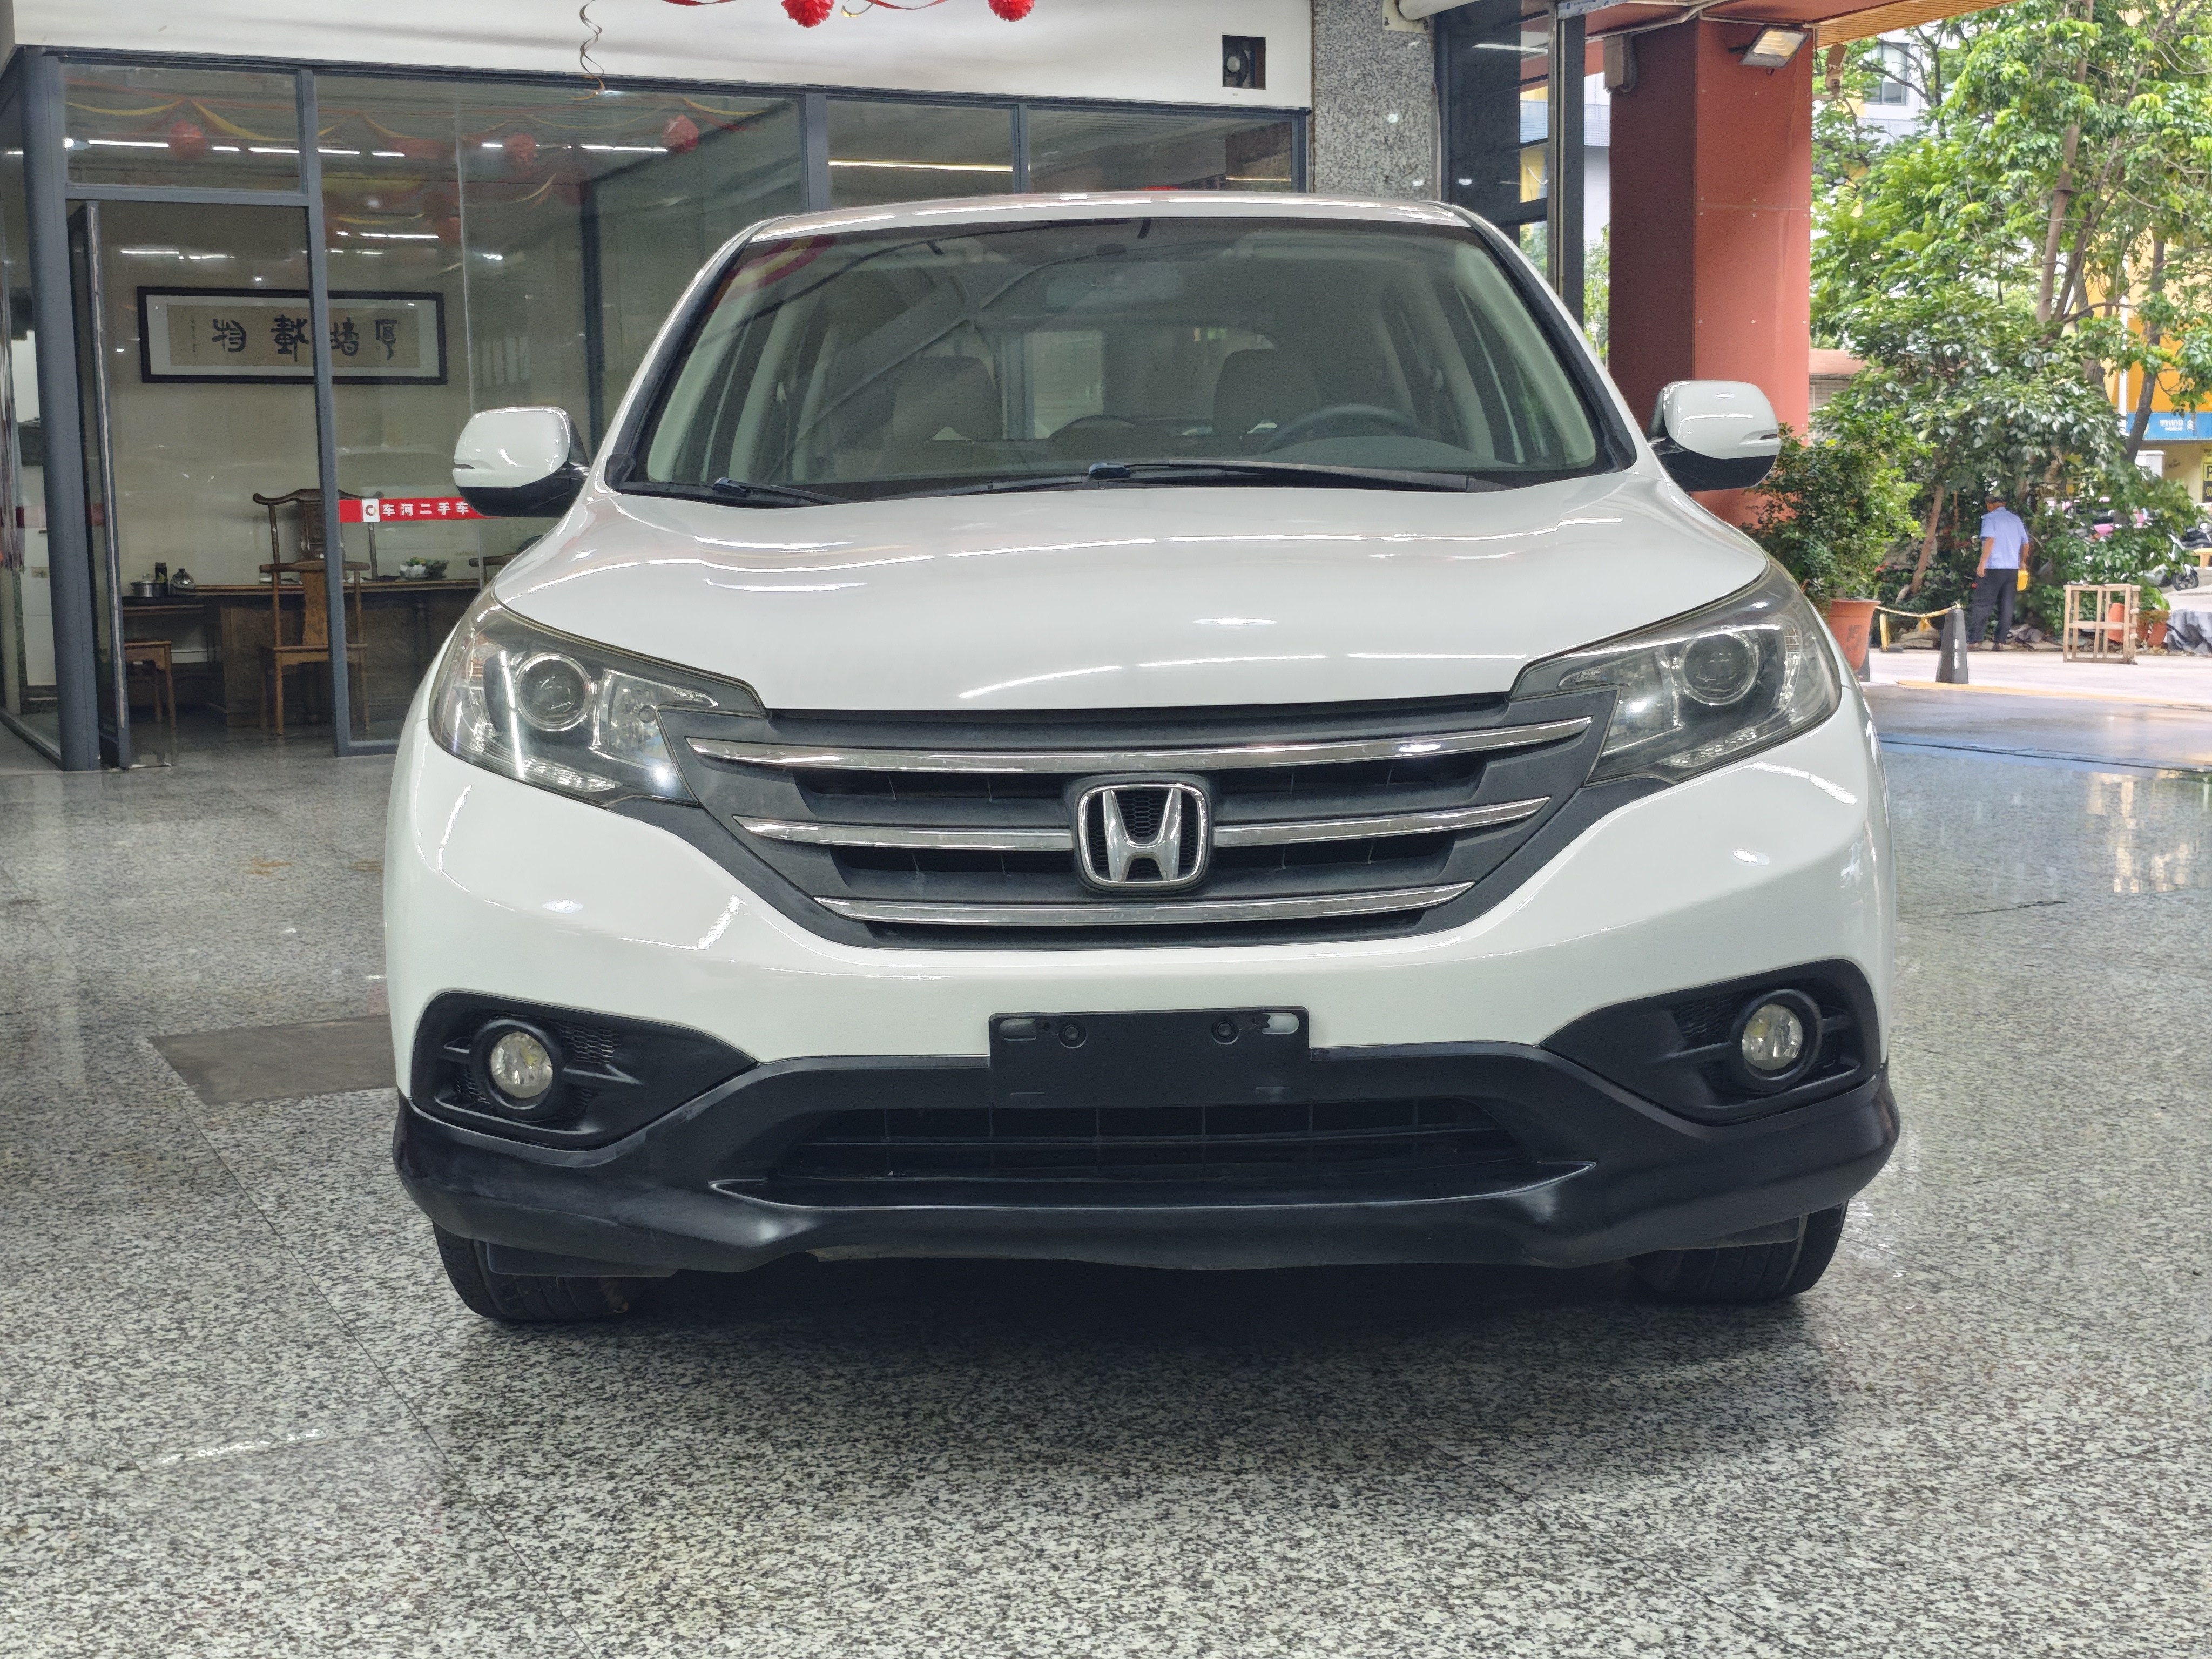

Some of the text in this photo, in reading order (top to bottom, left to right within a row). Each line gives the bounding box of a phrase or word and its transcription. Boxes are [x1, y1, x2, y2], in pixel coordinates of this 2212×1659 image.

[381, 502, 469, 517] 车河二手车
